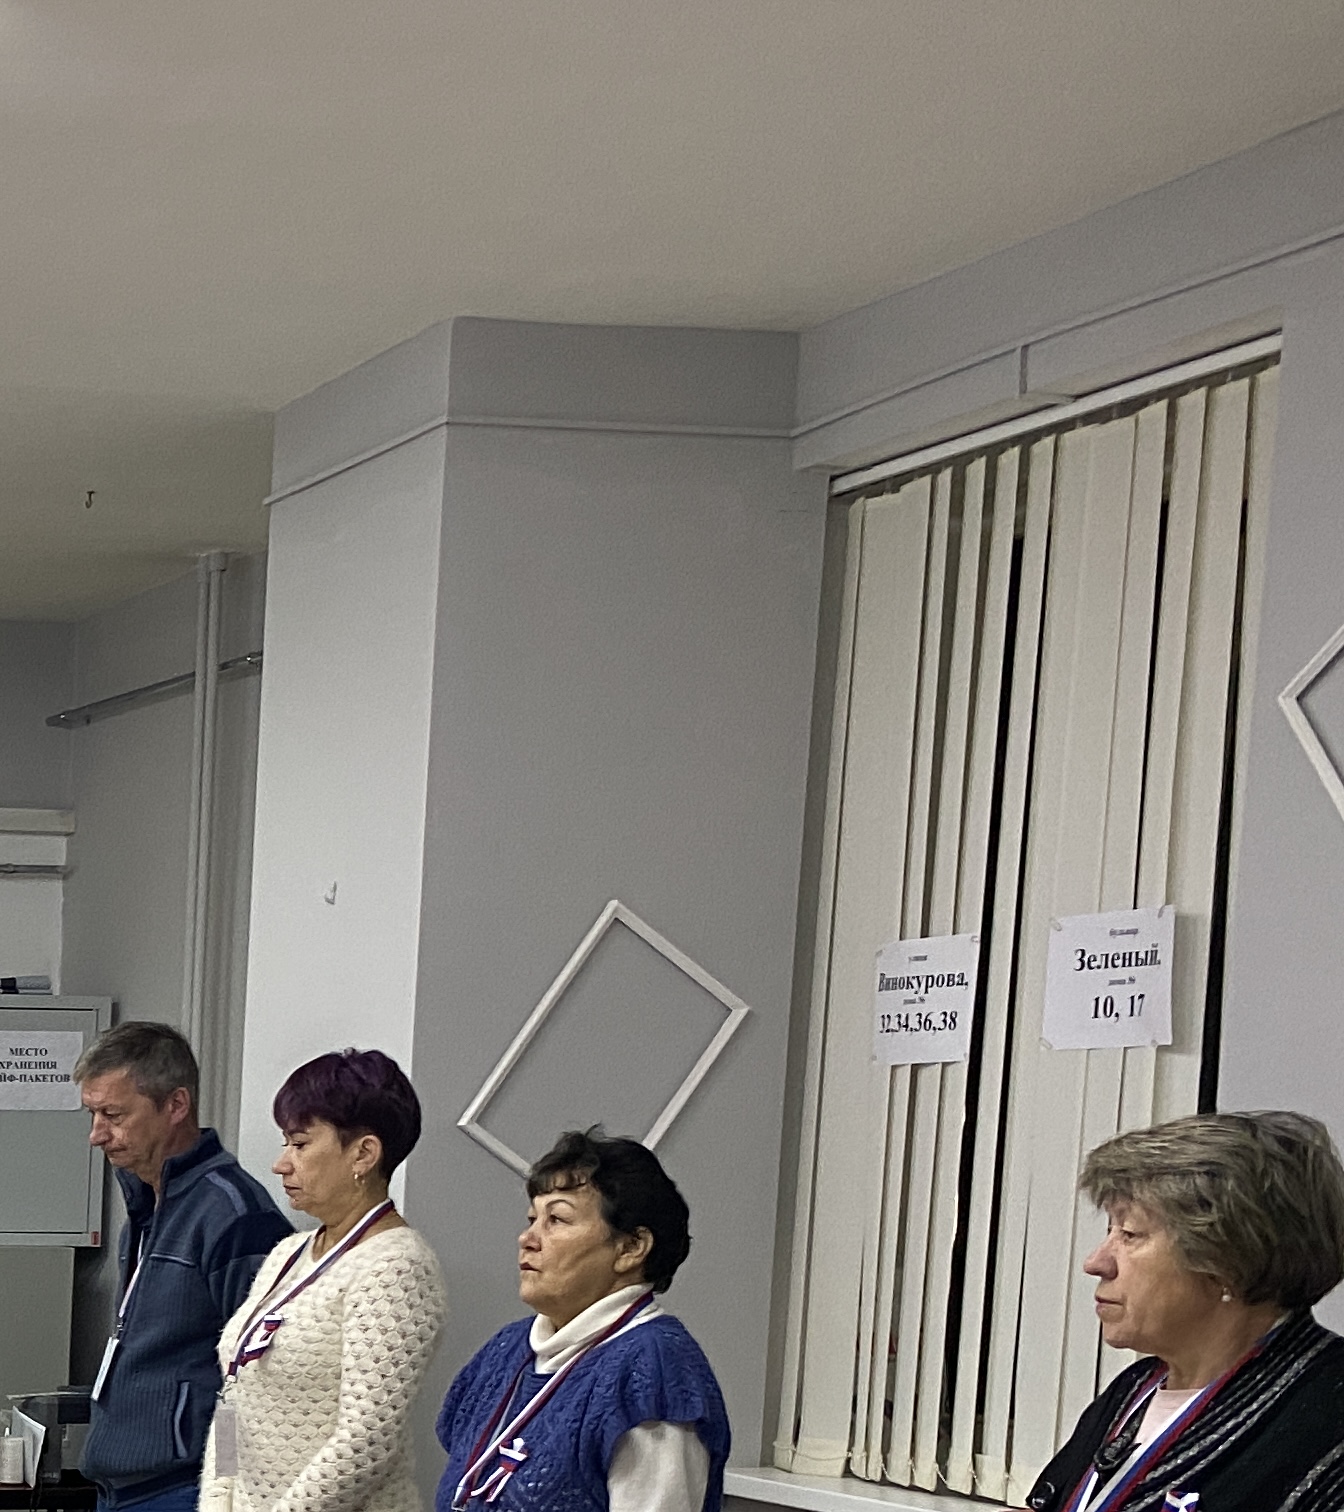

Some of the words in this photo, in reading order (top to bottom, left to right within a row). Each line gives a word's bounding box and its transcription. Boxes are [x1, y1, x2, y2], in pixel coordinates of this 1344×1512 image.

[1091, 996, 1120, 1023] 10,
[1128, 993, 1146, 1018] 17
[9, 1047, 48, 1057] МЕСТО
